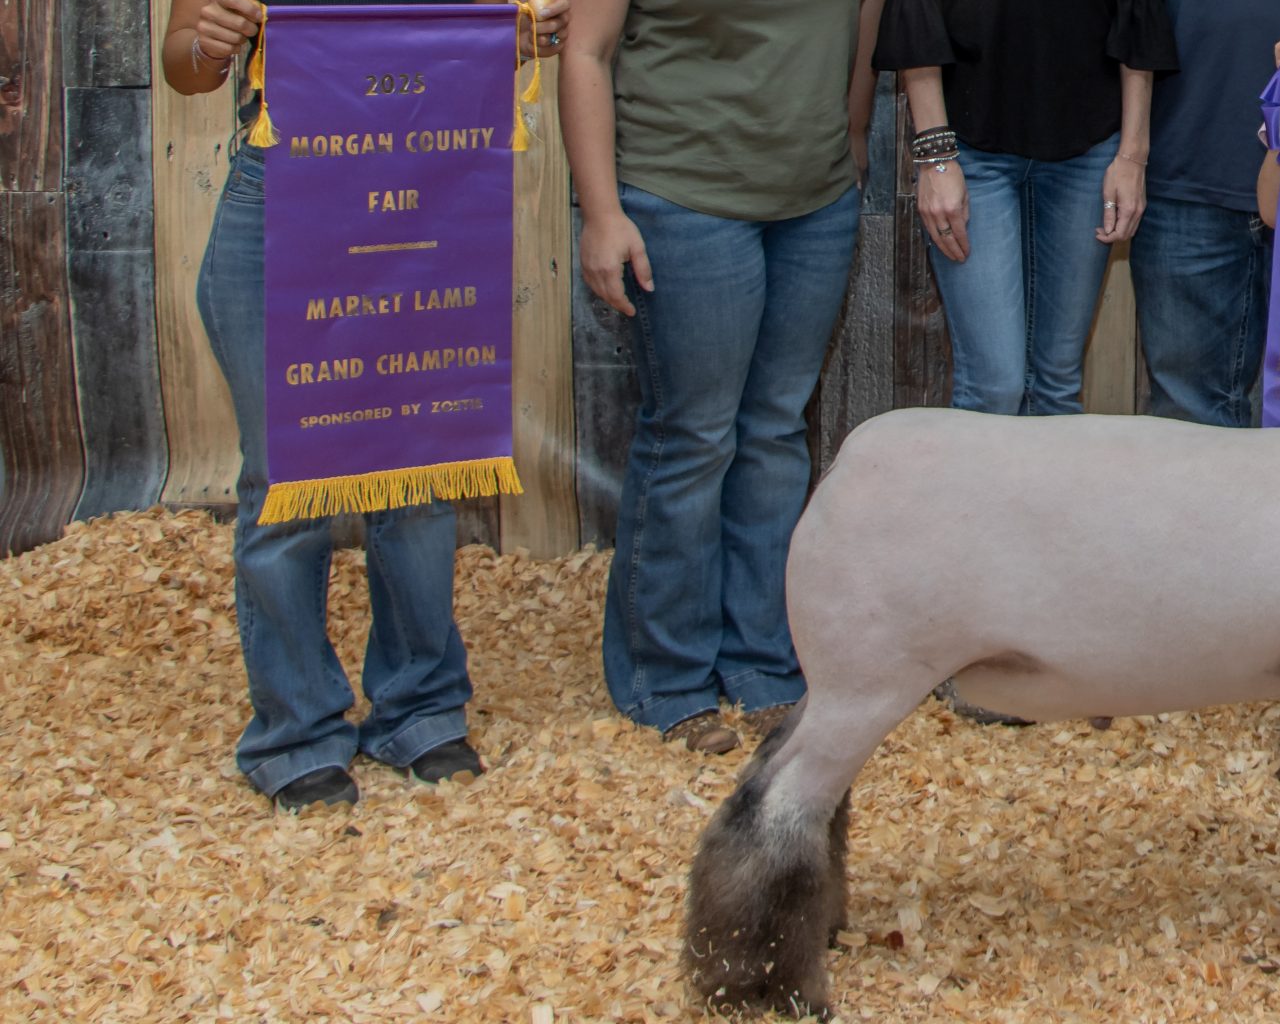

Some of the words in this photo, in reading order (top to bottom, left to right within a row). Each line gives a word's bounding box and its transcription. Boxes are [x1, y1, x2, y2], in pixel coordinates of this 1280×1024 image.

[365, 73, 427, 96] 2025
[289, 132, 393, 158] MORGAN
[405, 128, 494, 153] COUNTY
[368, 189, 420, 213] FAIR
[306, 294, 403, 320] MARKET
[414, 286, 477, 311] LAMB
[286, 357, 365, 385] GRAND
[376, 345, 497, 375] CHAMPION
[300, 407, 393, 429] SPONSORED
[401, 403, 422, 417] BY
